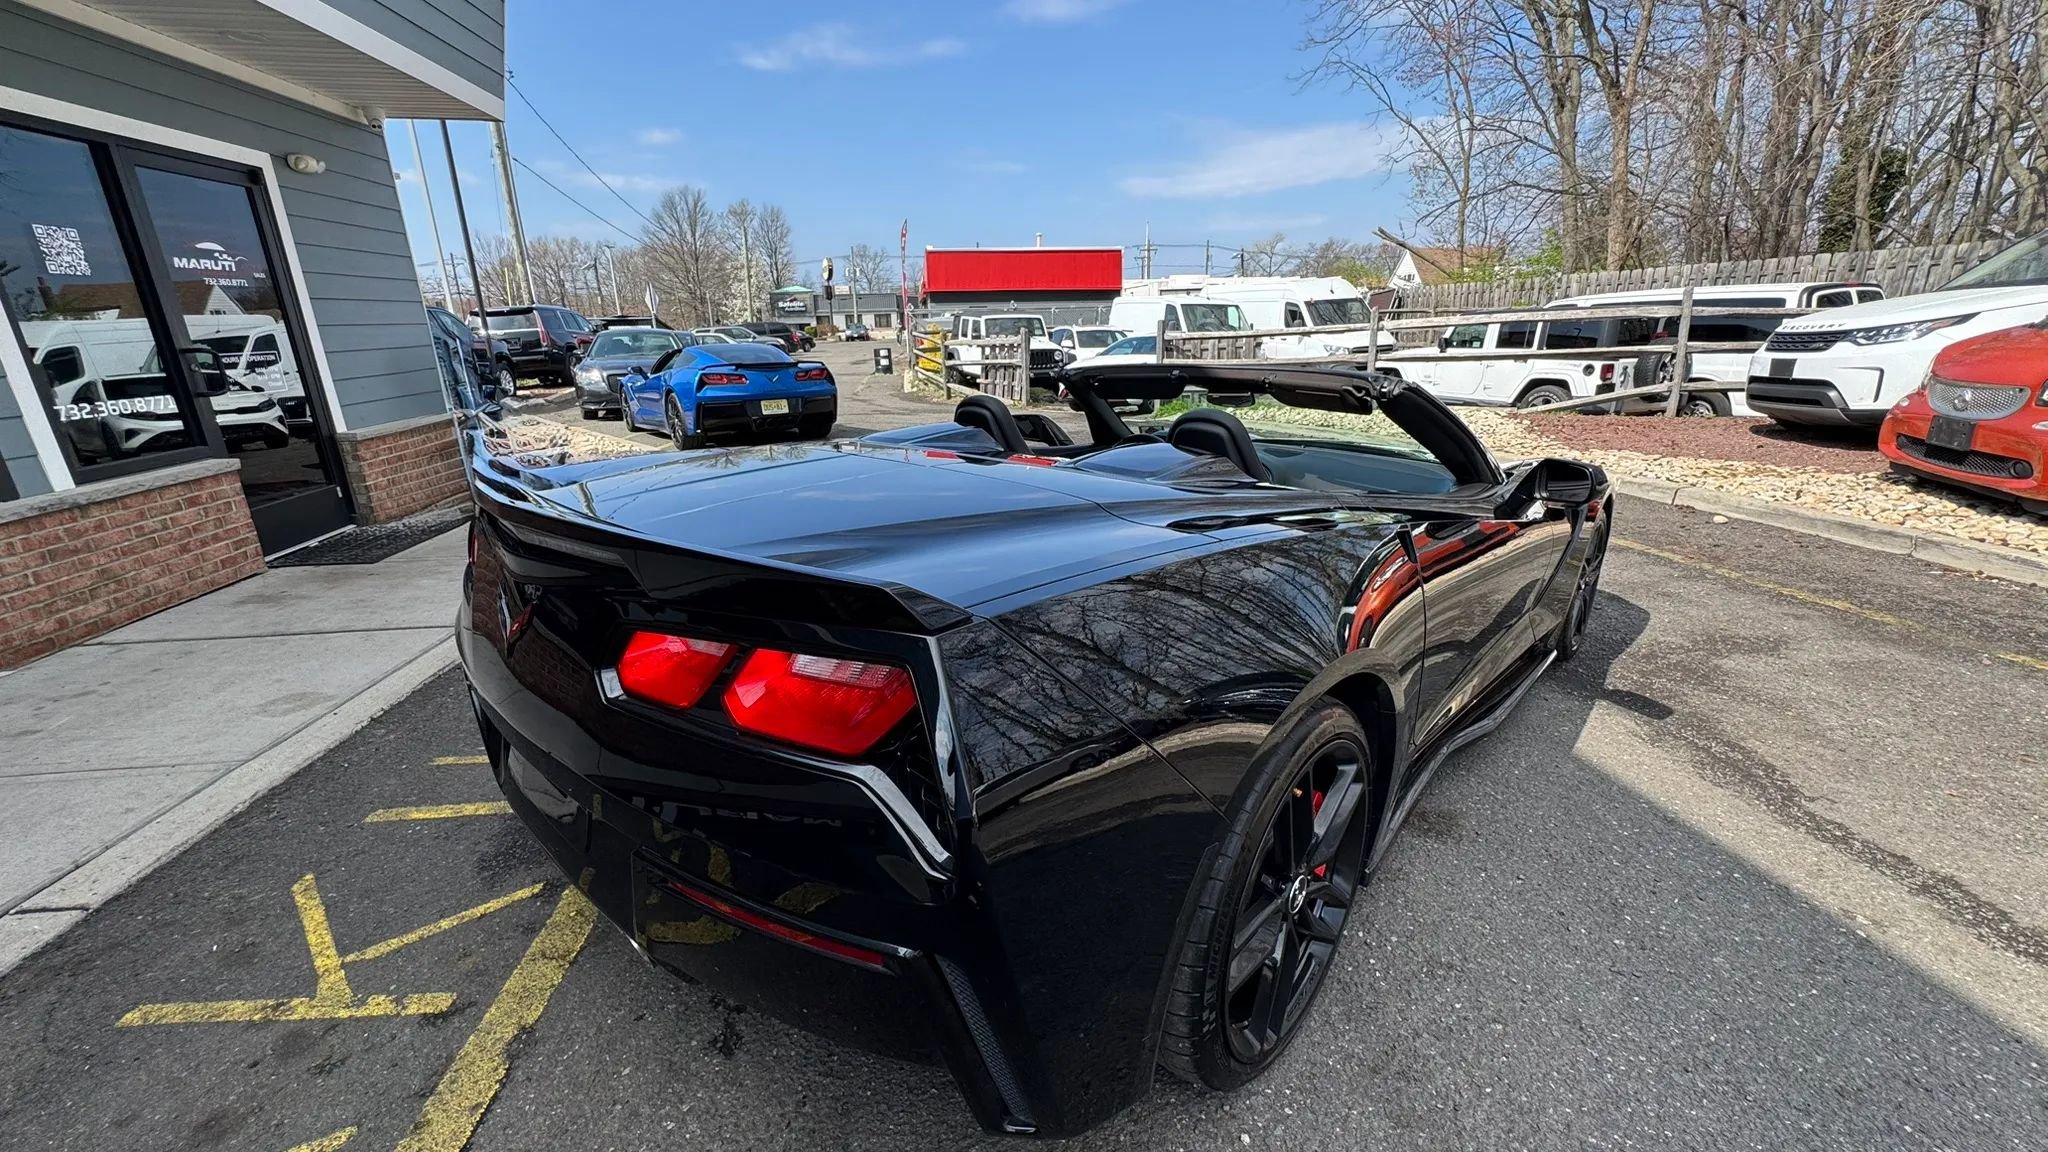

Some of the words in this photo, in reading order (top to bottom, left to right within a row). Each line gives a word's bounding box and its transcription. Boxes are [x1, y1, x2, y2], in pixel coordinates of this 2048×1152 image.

[173, 257, 236, 272] MARUTI
[203, 277, 248, 287] 732.360.8771
[53, 394, 177, 422] 732.360.8771
